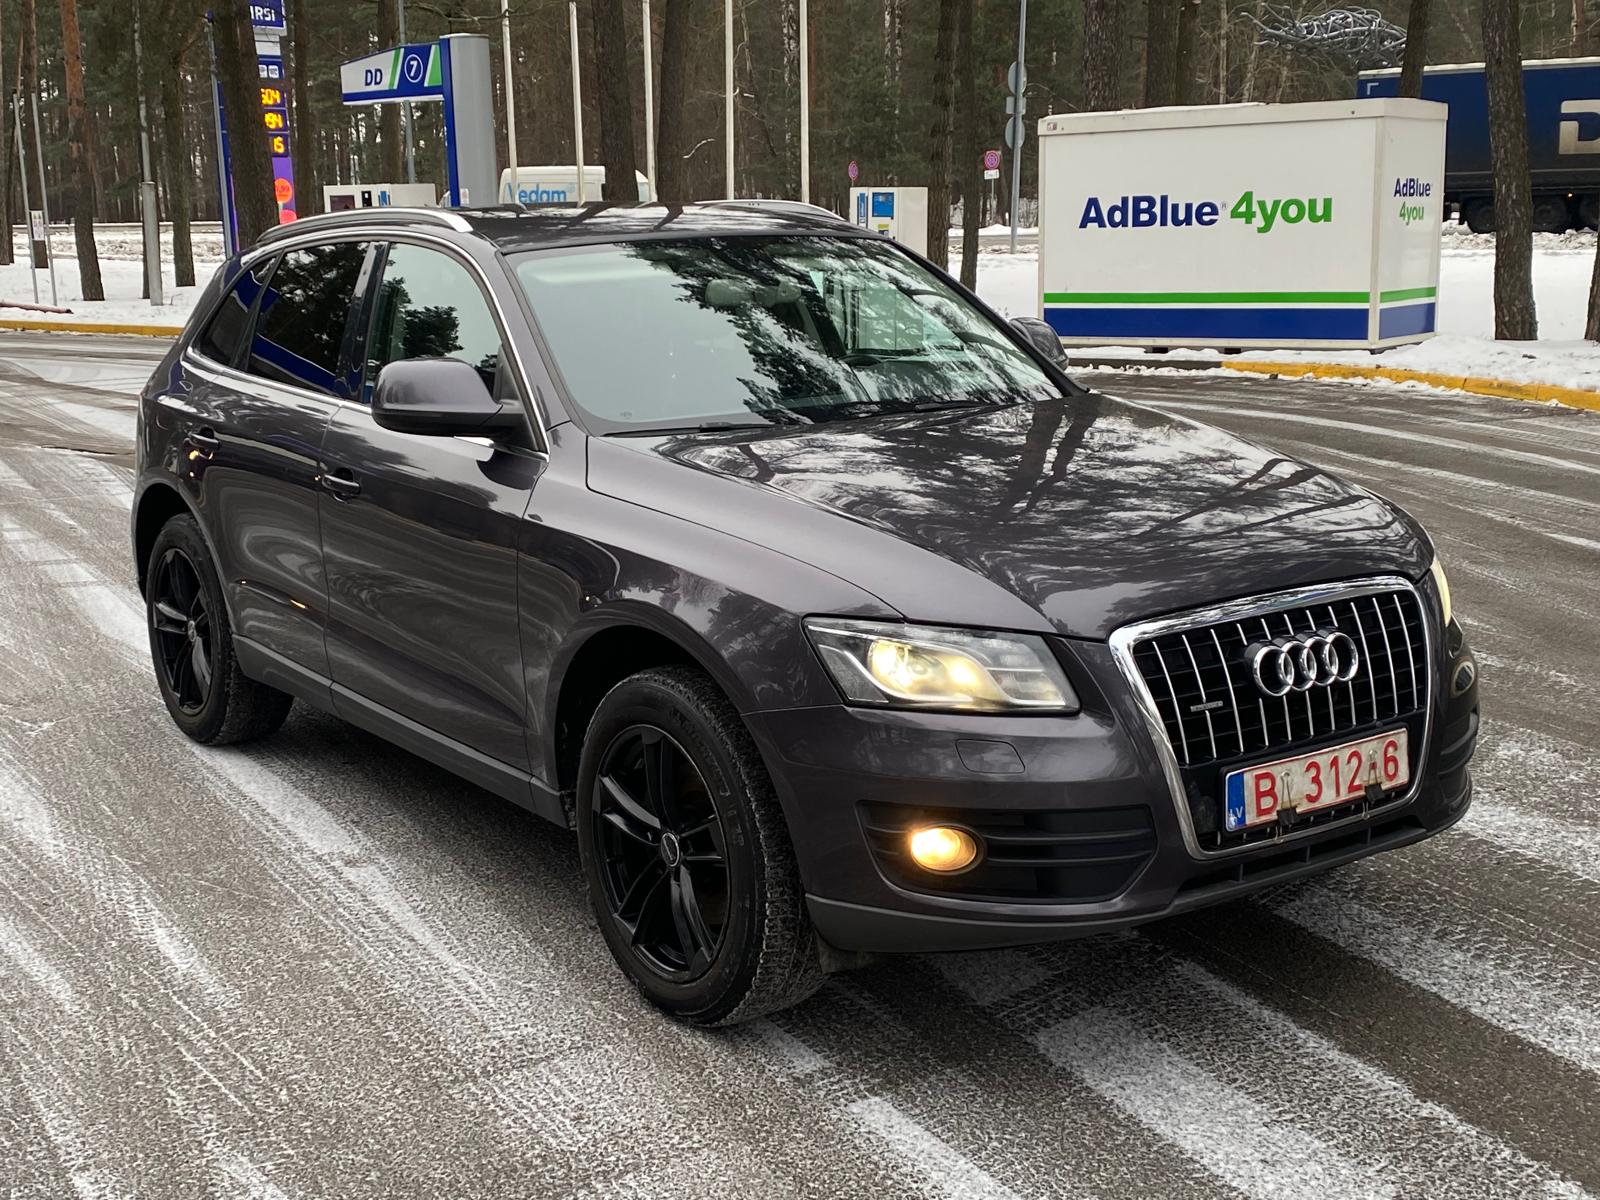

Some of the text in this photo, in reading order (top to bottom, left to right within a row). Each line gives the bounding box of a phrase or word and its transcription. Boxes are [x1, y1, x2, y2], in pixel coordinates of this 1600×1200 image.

[365, 60, 418, 86] DD 7
[1394, 178, 1431, 197] AdBlue
[1230, 191, 1333, 234] 4you
[1400, 201, 1424, 226] 4you
[1254, 771, 1279, 817] B
